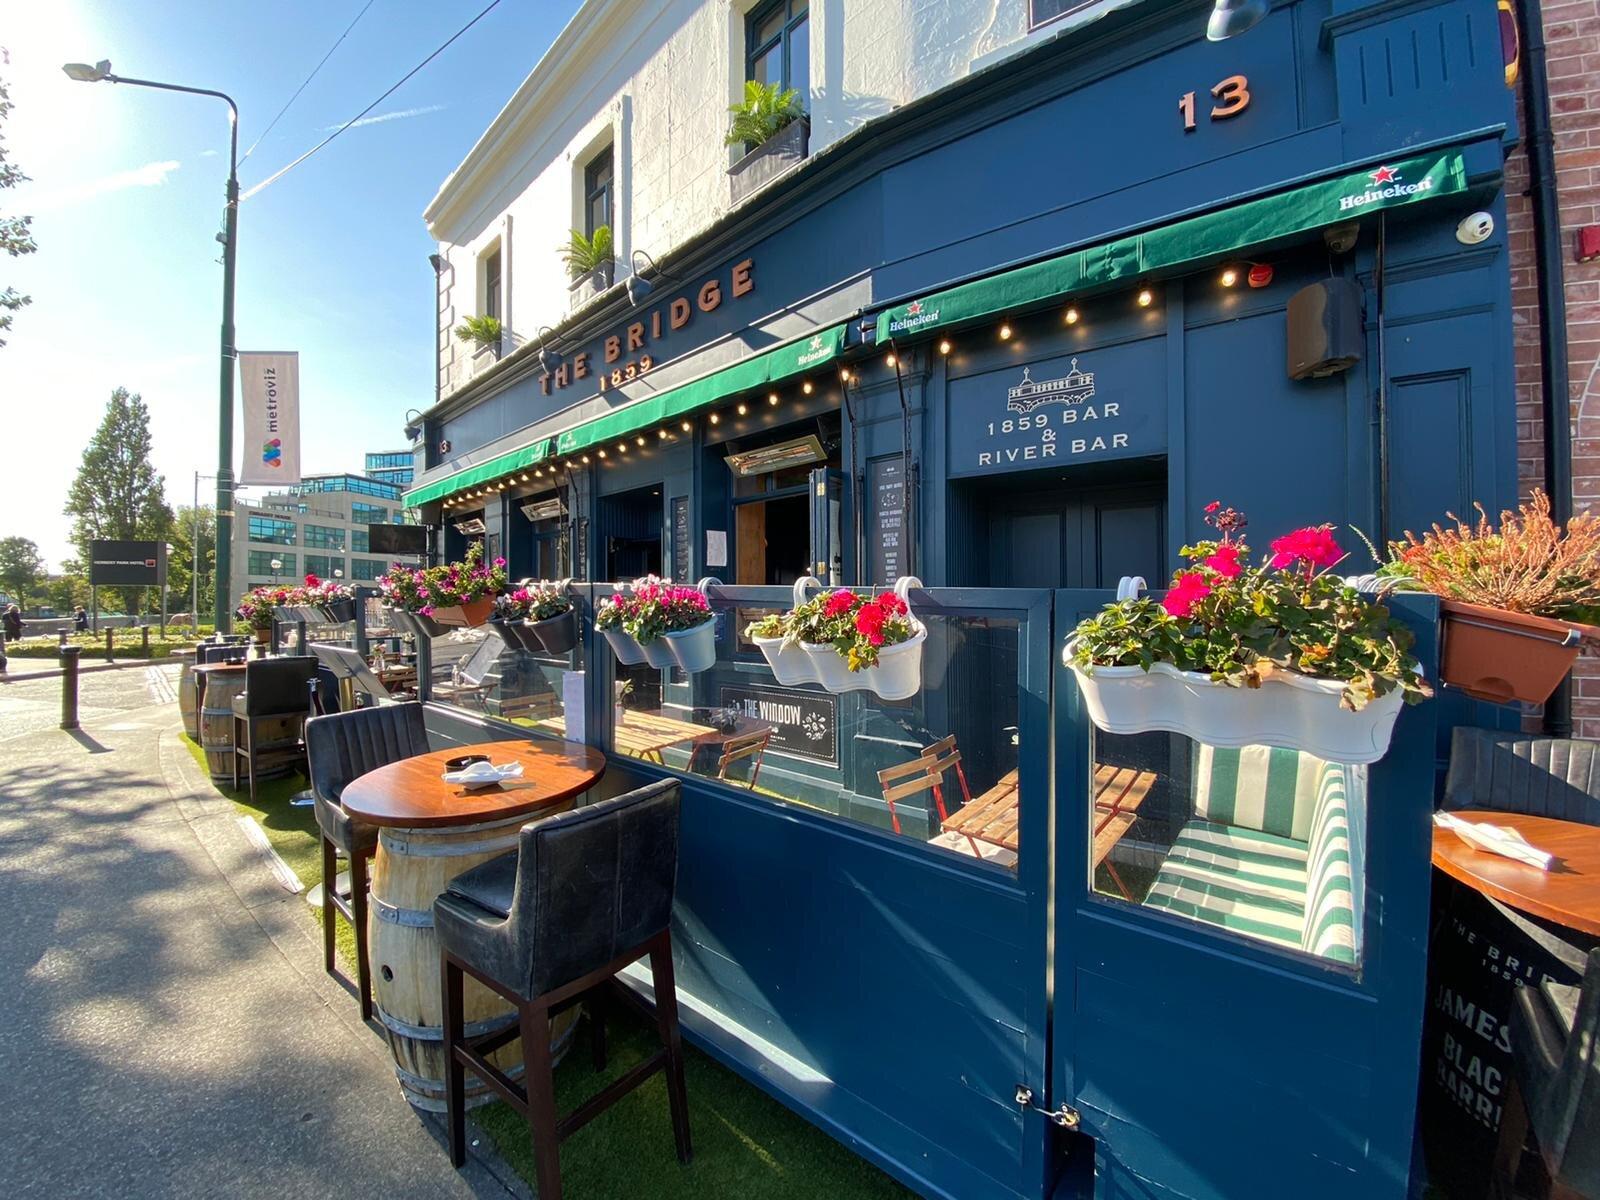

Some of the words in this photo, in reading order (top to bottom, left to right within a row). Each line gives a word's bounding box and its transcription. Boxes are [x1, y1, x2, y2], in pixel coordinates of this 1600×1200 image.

[1178, 74, 1250, 129] 13
[1339, 176, 1433, 211] Heineken
[538, 352, 588, 396] THE
[604, 258, 754, 364] BRIDGE
[889, 310, 939, 332] Heineken
[599, 354, 653, 391] 1859
[264, 368, 278, 433] metroviz
[988, 414, 1048, 436] 1859
[1062, 402, 1120, 425] BAR
[1041, 428, 1056, 442] &
[978, 443, 1057, 466] RIVER
[1071, 433, 1129, 454] BAR
[743, 699, 758, 719] THE
